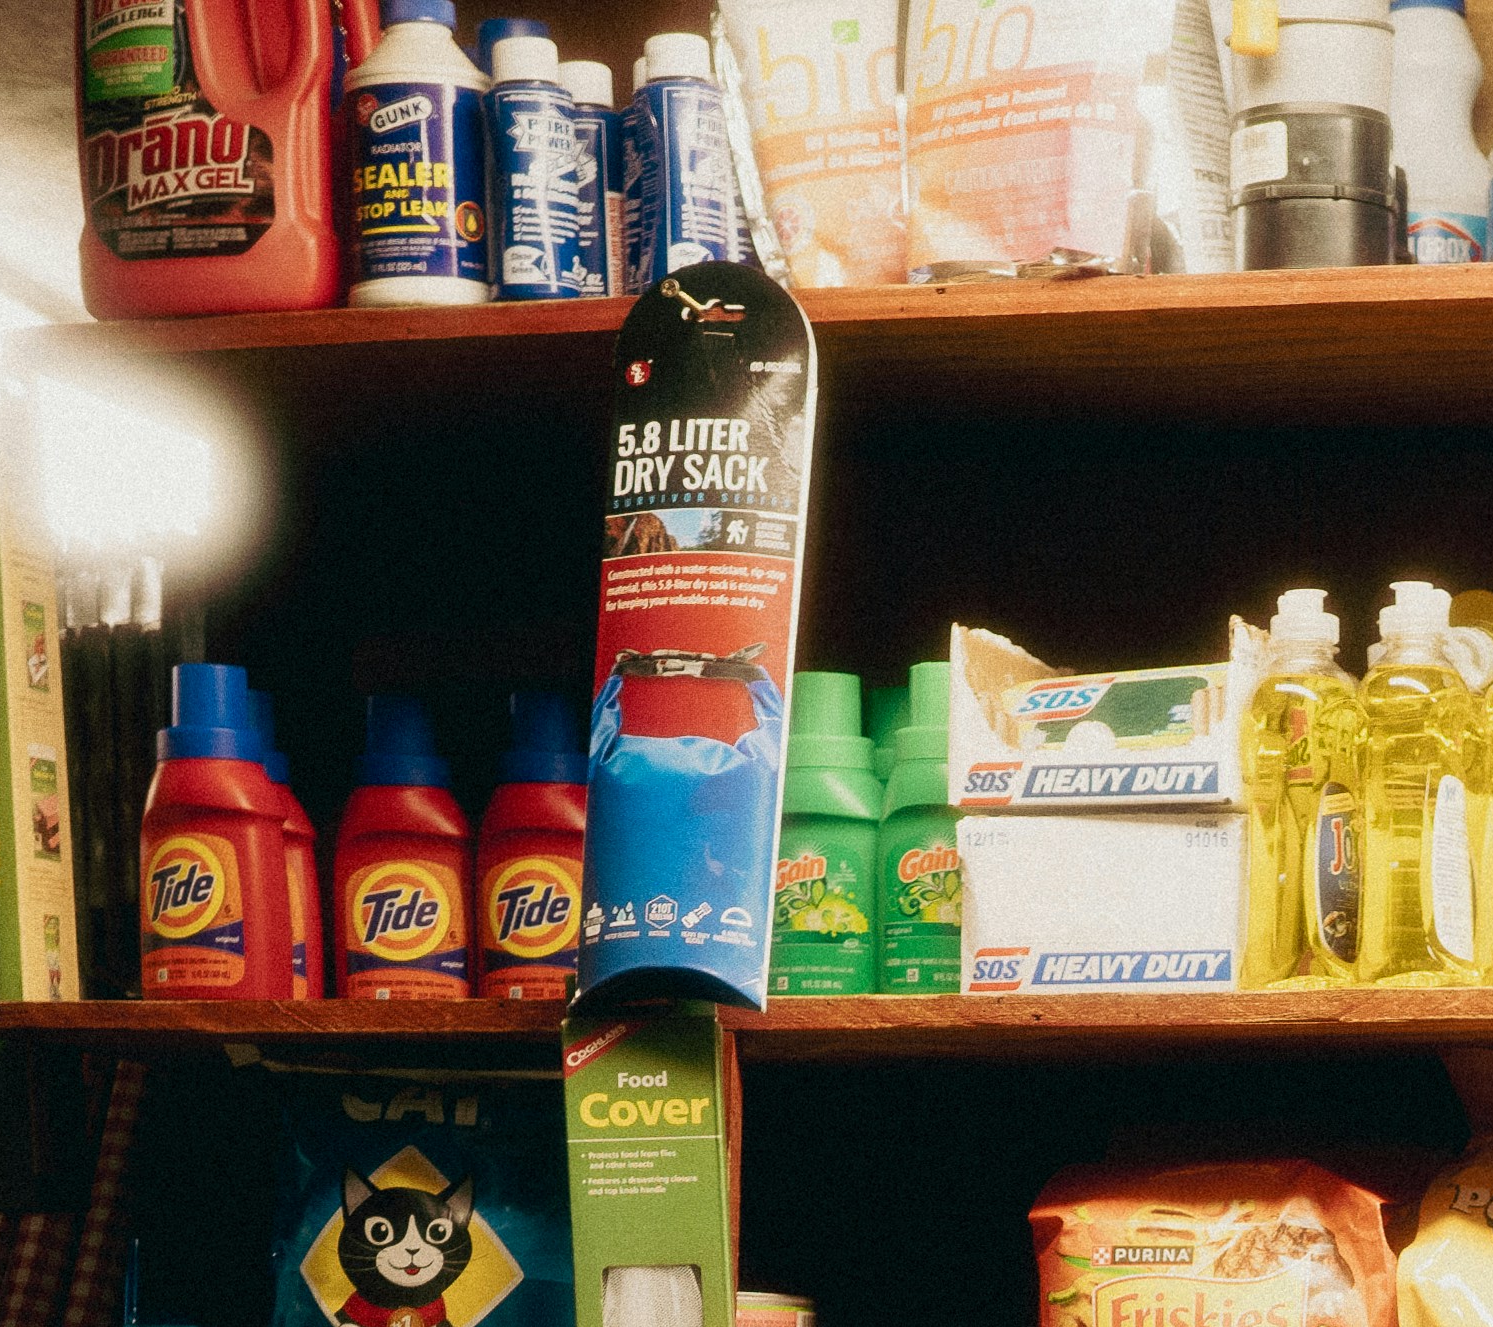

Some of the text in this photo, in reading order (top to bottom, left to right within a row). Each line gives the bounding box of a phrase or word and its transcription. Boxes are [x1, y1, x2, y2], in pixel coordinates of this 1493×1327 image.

[374, 101, 424, 130] GUNK
[130, 165, 252, 208] MAX GEL
[353, 162, 450, 192] SEALER
[355, 199, 450, 221] STOP LEAK
[617, 417, 752, 458] 5.8 LITER
[613, 453, 770, 498] DRY SACK
[149, 860, 216, 926] Tide
[496, 882, 573, 943] Tide
[361, 882, 440, 945] Tide
[617, 1070, 668, 1089] Food
[579, 1091, 711, 1129] Cover
[1113, 1246, 1193, 1265] PURINA
